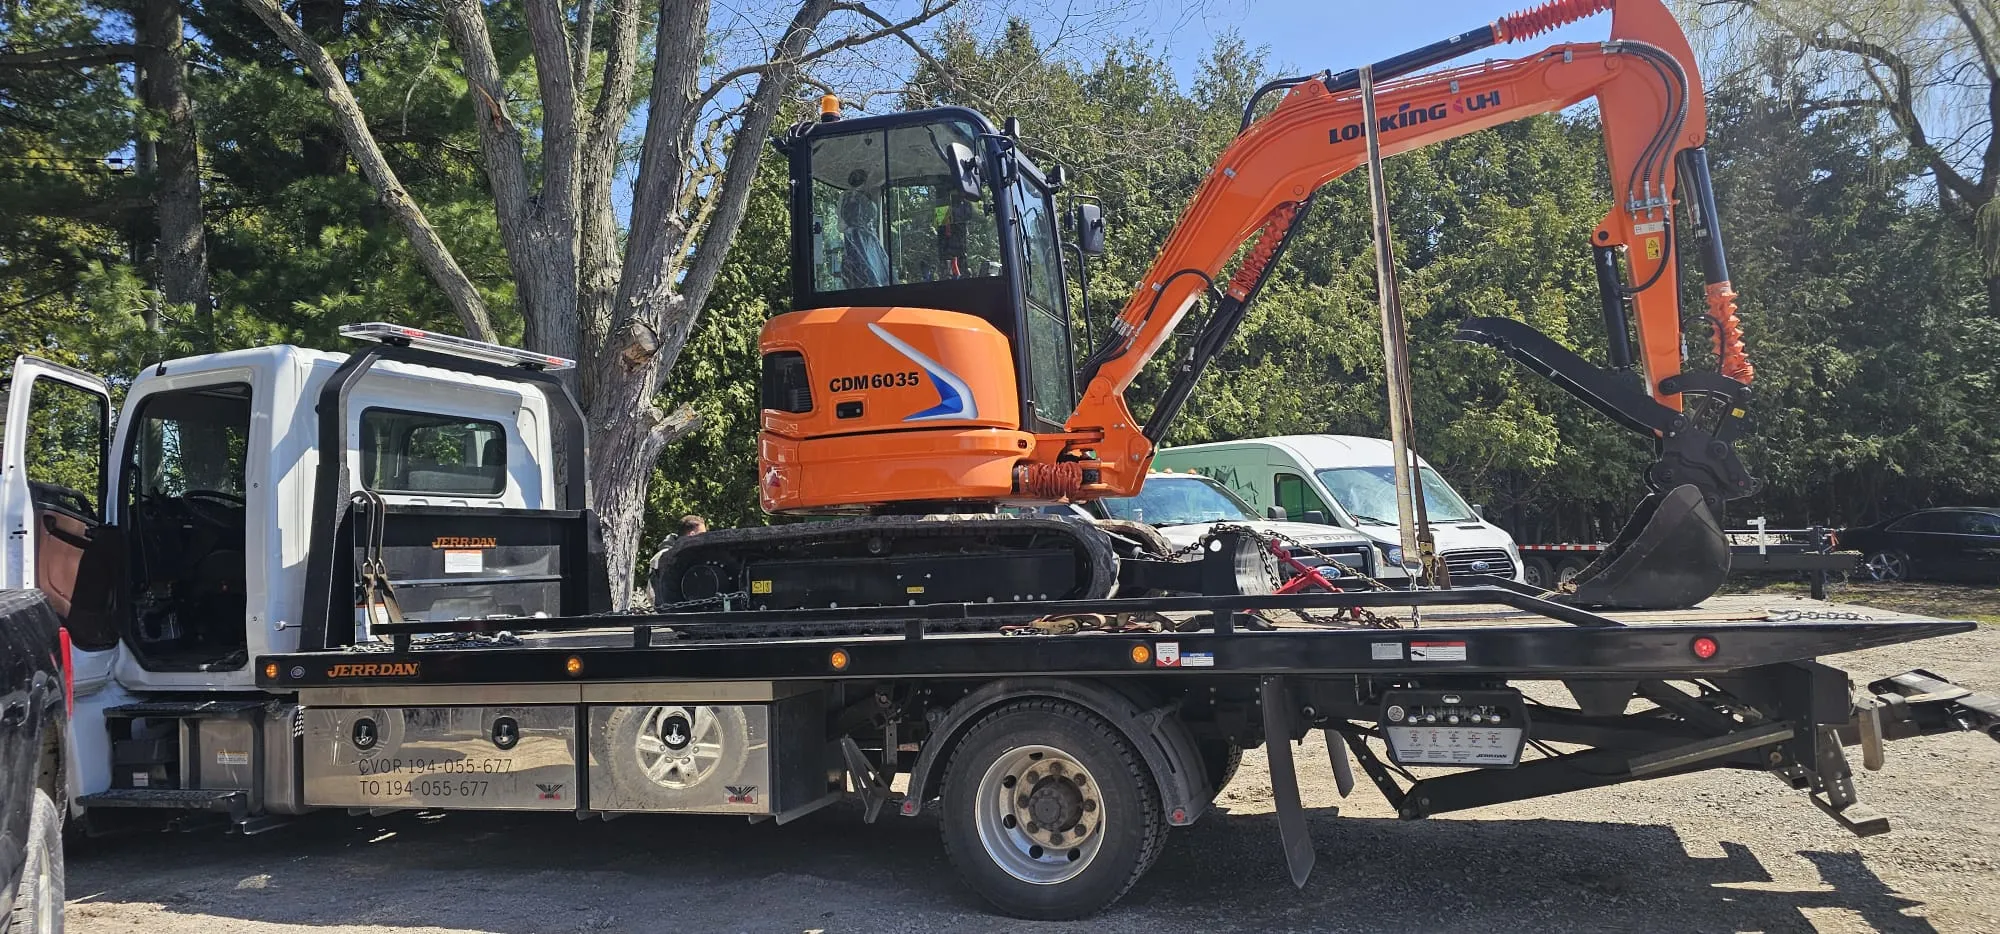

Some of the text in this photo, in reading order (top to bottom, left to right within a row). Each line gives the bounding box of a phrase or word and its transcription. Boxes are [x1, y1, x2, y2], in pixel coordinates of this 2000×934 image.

[358, 758, 513, 775] CVOR 194-055-677
[359, 780, 490, 797] TO 194-055-677
